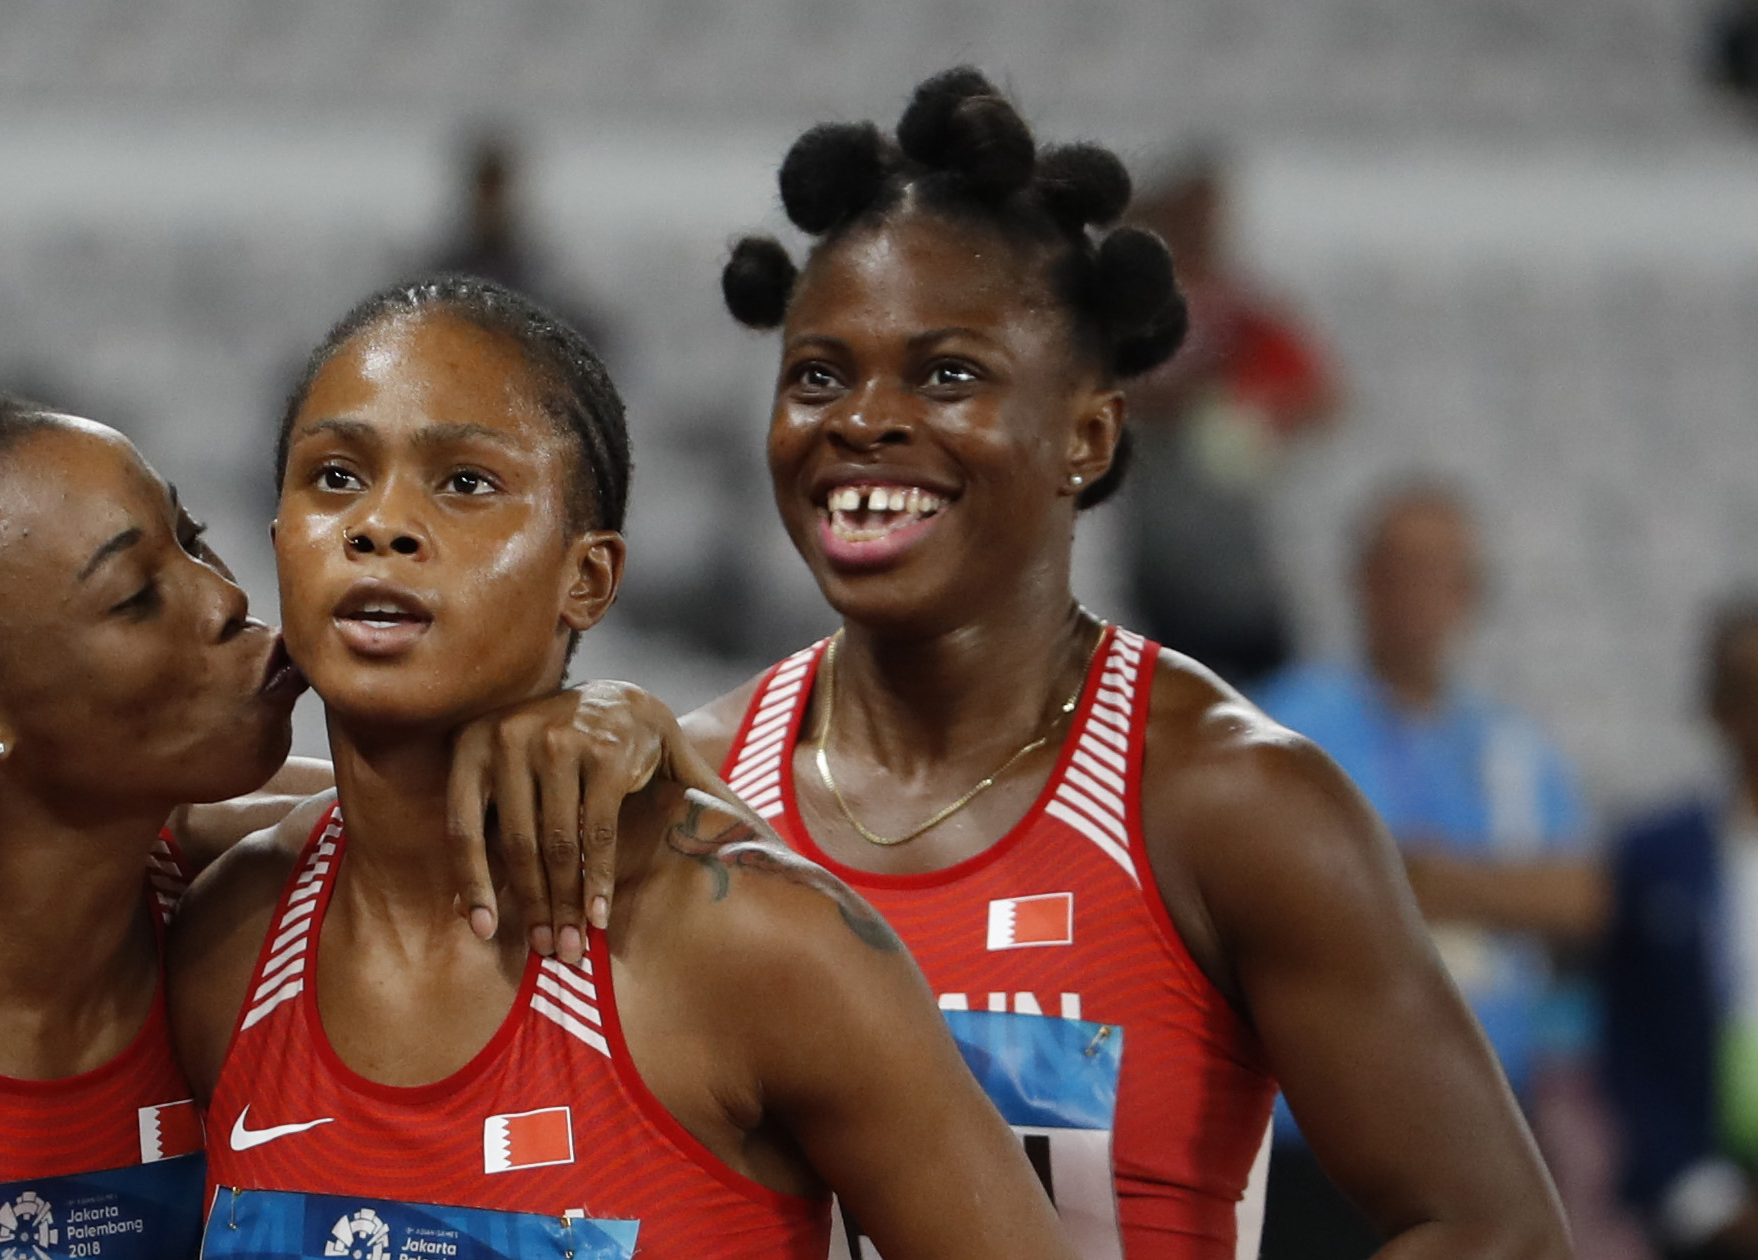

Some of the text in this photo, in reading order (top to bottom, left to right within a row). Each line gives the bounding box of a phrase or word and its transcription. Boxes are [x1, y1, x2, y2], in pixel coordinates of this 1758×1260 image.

[67, 1206, 119, 1223] Jakarta
[67, 1219, 143, 1240] Palembang
[69, 1241, 101, 1258] 2018
[402, 1237, 457, 1256] Jakarta
